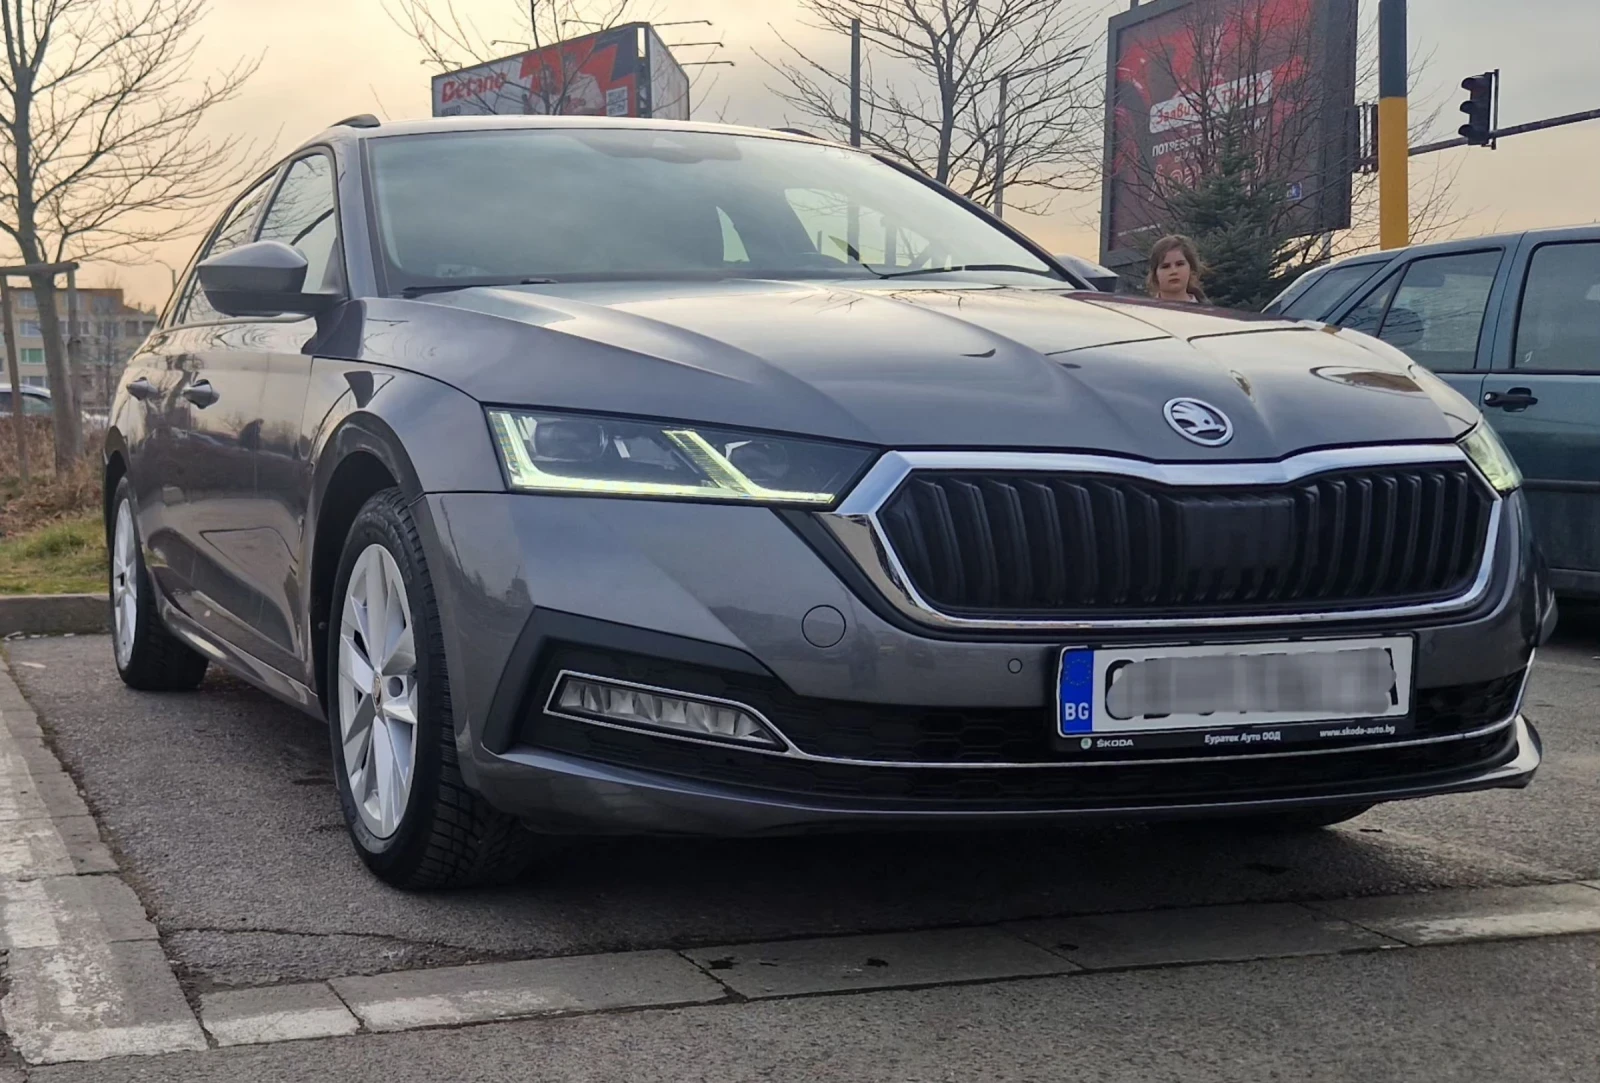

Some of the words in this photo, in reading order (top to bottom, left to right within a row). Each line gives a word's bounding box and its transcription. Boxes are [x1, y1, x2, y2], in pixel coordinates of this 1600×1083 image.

[441, 72, 507, 103] Betano
[1064, 702, 1090, 721] BG
[1240, 733, 1261, 744] Ауто
[1262, 731, 1281, 742] ООД
[1319, 725, 1396, 738] www.skoda-auto.bg
